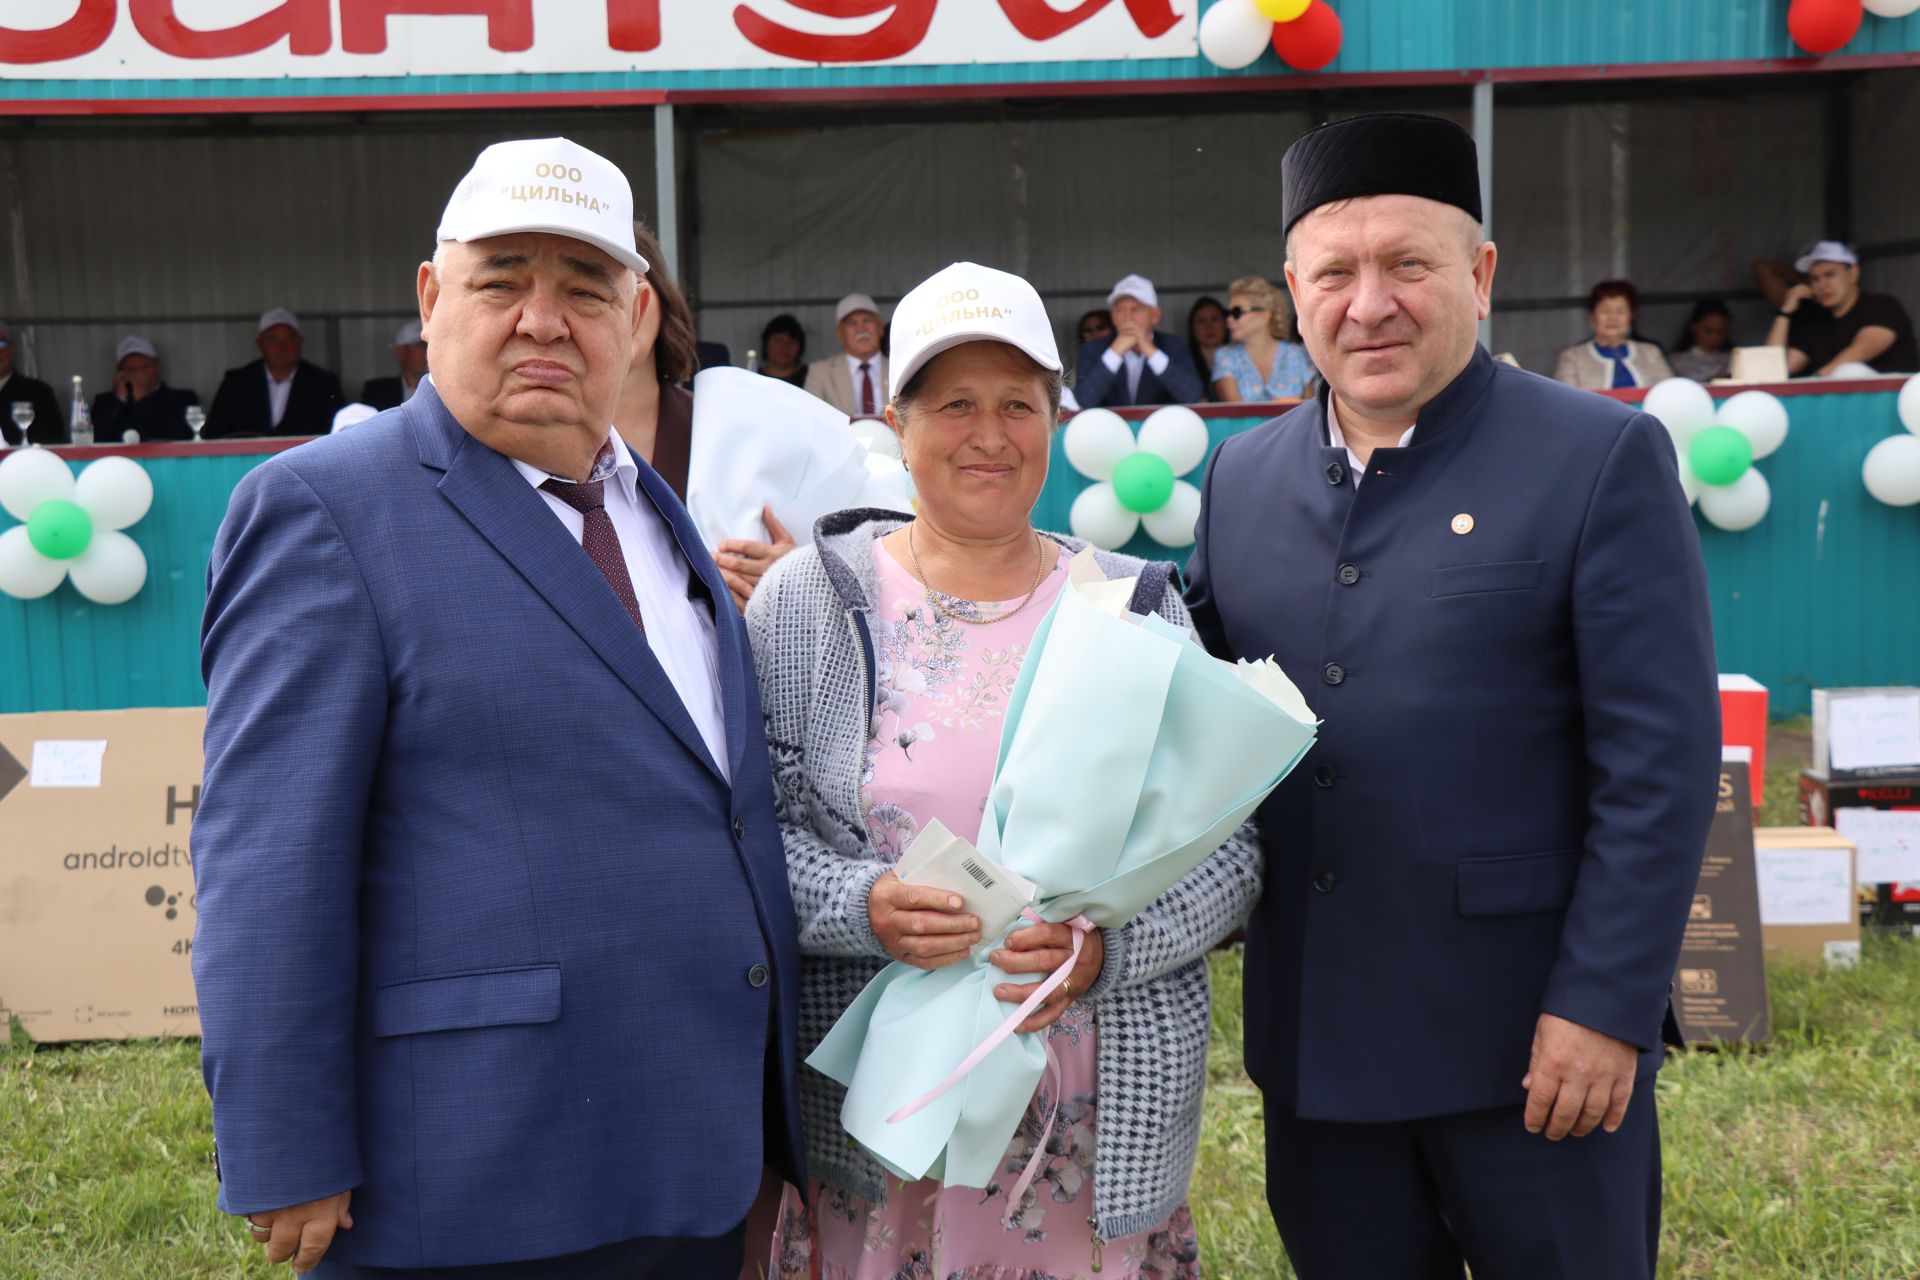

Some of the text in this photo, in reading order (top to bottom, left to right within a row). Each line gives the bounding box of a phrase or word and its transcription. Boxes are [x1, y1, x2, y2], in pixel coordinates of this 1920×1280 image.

[535, 163, 582, 183] ООО
[500, 184, 610, 215] "ЦИЛЬНА"
[937, 287, 980, 308] ООО
